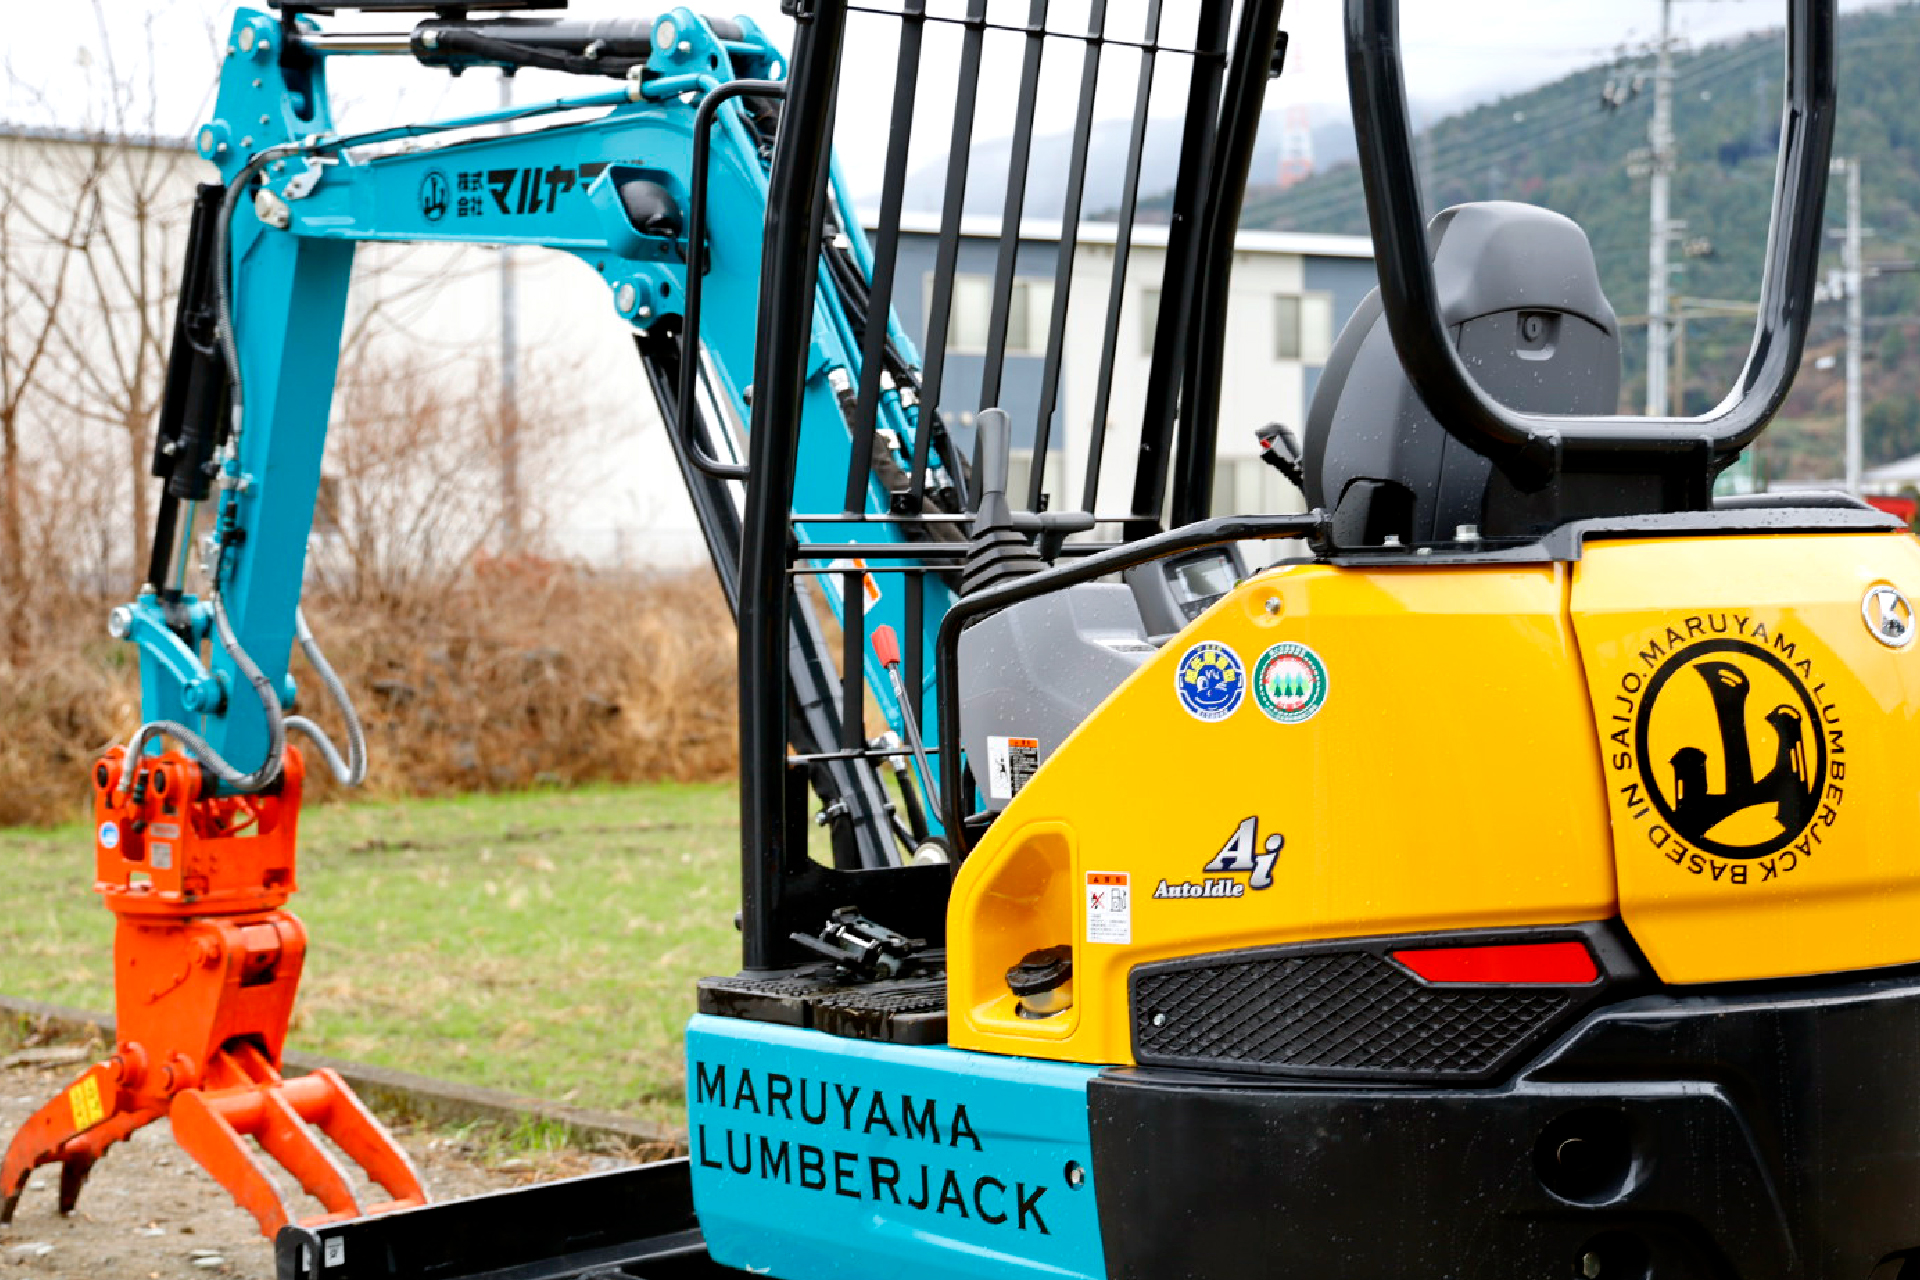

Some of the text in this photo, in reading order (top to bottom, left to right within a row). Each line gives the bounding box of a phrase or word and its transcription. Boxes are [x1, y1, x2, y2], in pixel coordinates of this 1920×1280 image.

[1639, 613, 1812, 681] MARUYAMA
[1620, 783, 1650, 820] IN
[1758, 682, 1847, 883] LUMBERJACK
[1202, 815, 1285, 890] Ai
[1648, 825, 1748, 885] BASED
[696, 1061, 984, 1152] MARUYAMA
[698, 1124, 1051, 1235] LUMBERJACK
